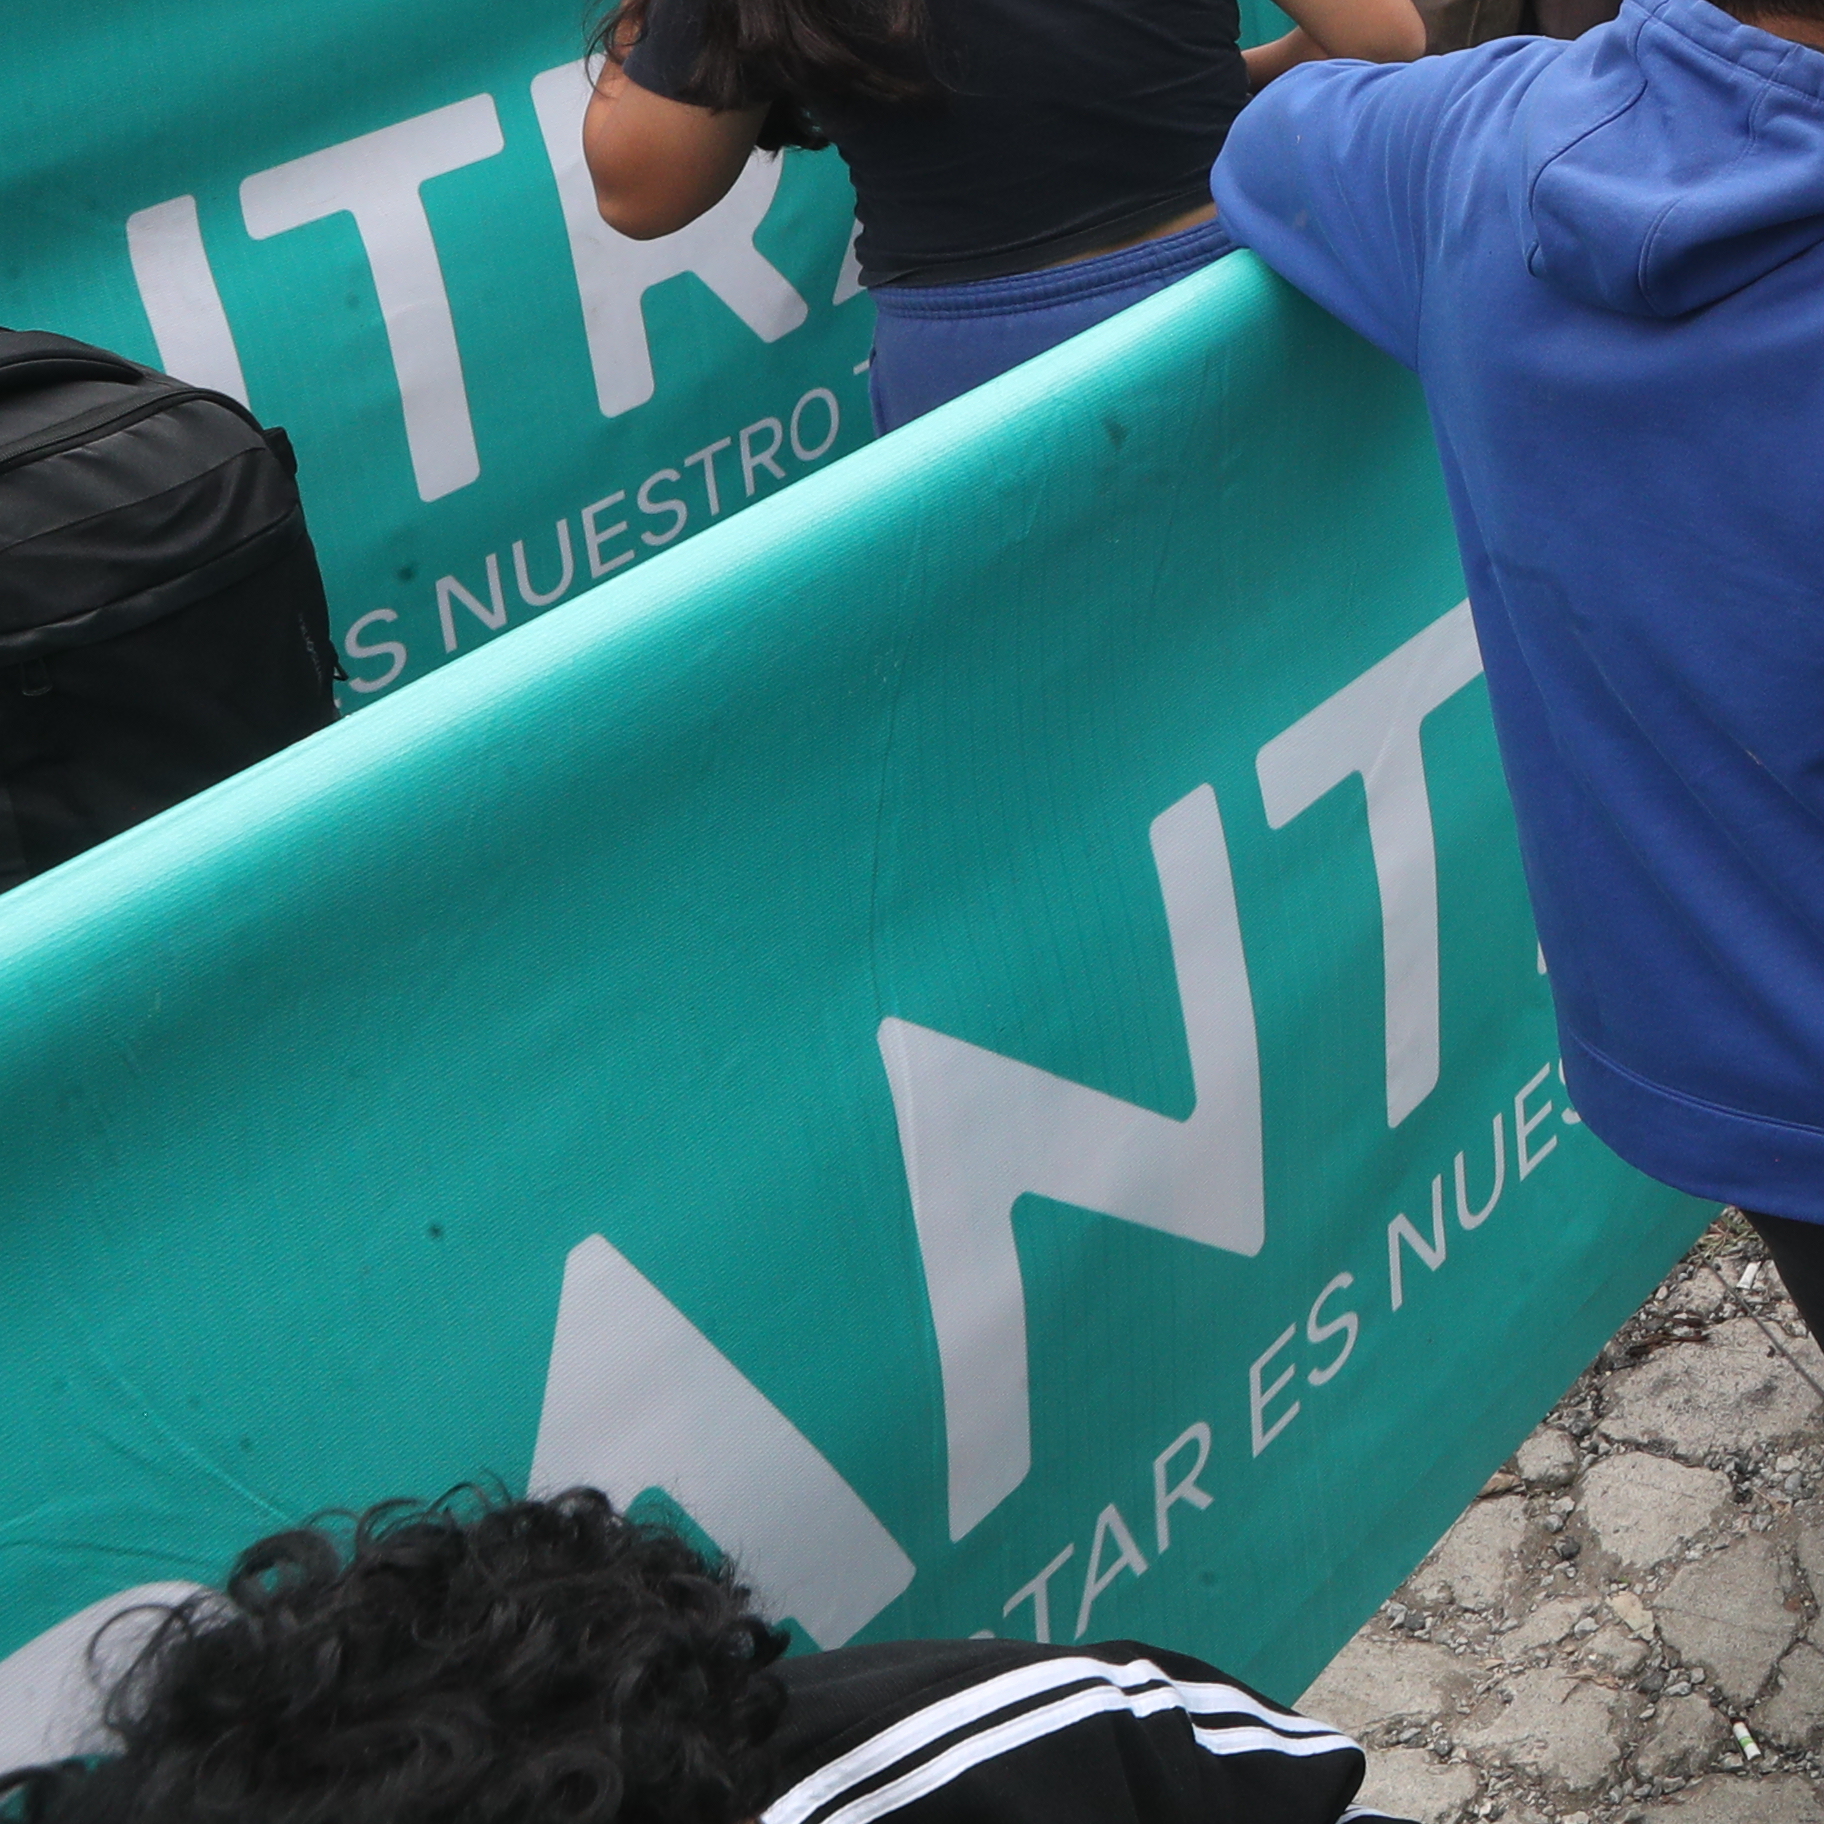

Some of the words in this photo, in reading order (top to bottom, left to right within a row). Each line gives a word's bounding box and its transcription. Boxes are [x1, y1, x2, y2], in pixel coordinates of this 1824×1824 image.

[435, 386, 841, 654] NUESTRO
[970, 1418, 1218, 1649] TAR
[1248, 1273, 1361, 1456] ES
